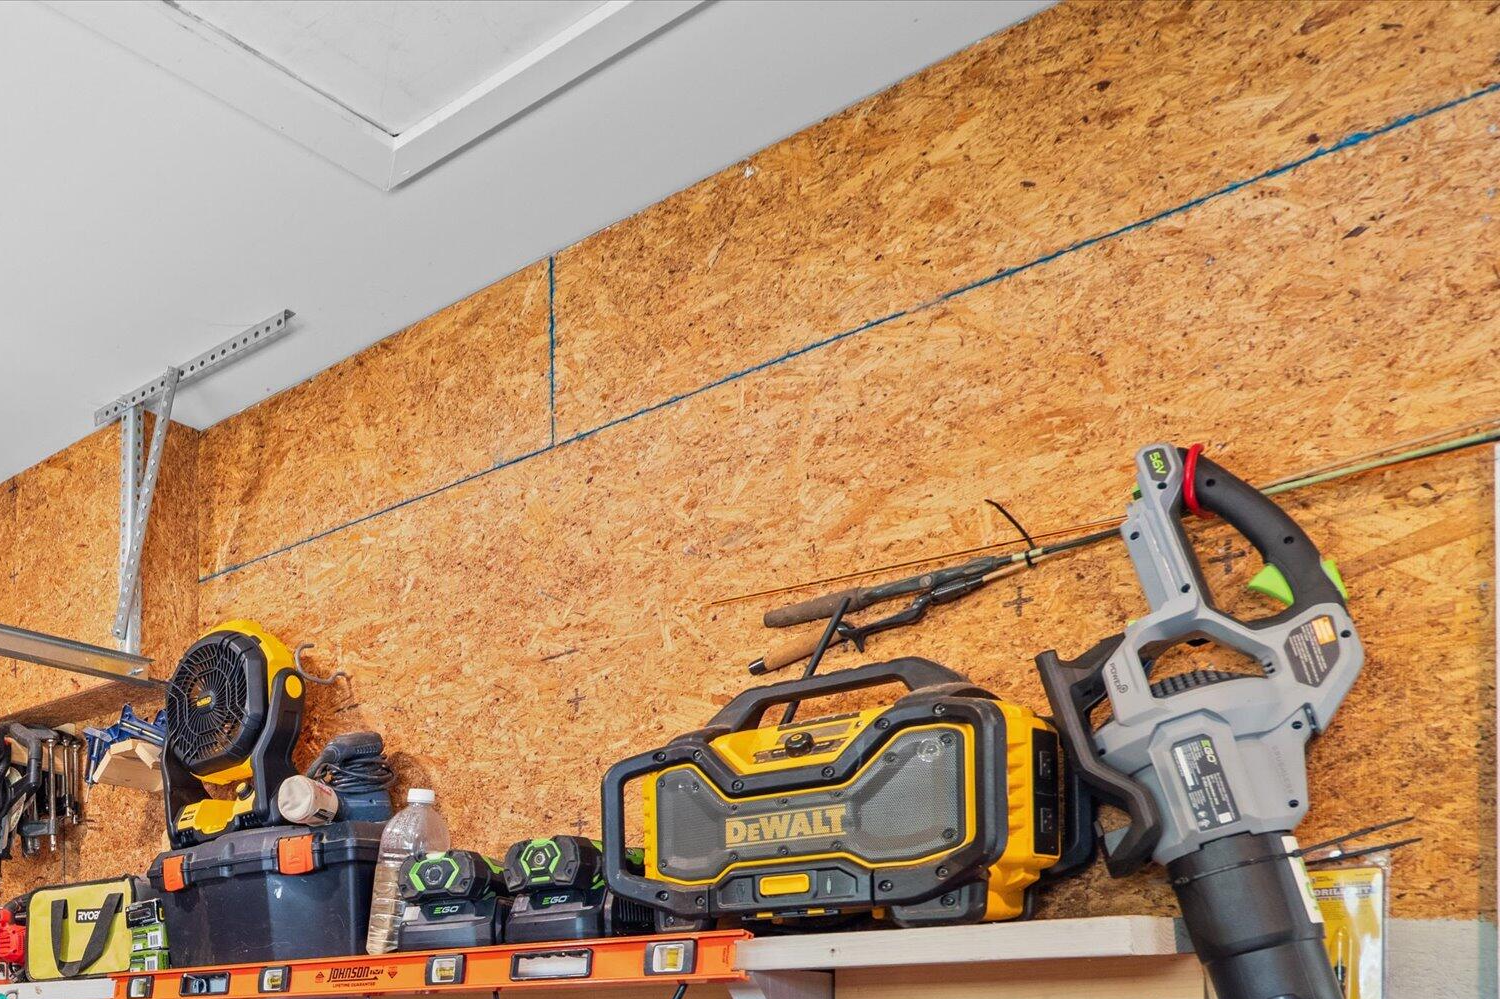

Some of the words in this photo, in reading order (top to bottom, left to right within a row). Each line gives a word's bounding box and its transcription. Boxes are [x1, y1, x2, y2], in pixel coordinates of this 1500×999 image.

[1150, 452, 1167, 474] 56V
[542, 895, 567, 905] EGO
[433, 905, 458, 914] EGO
[327, 966, 370, 982] JOHNSON
